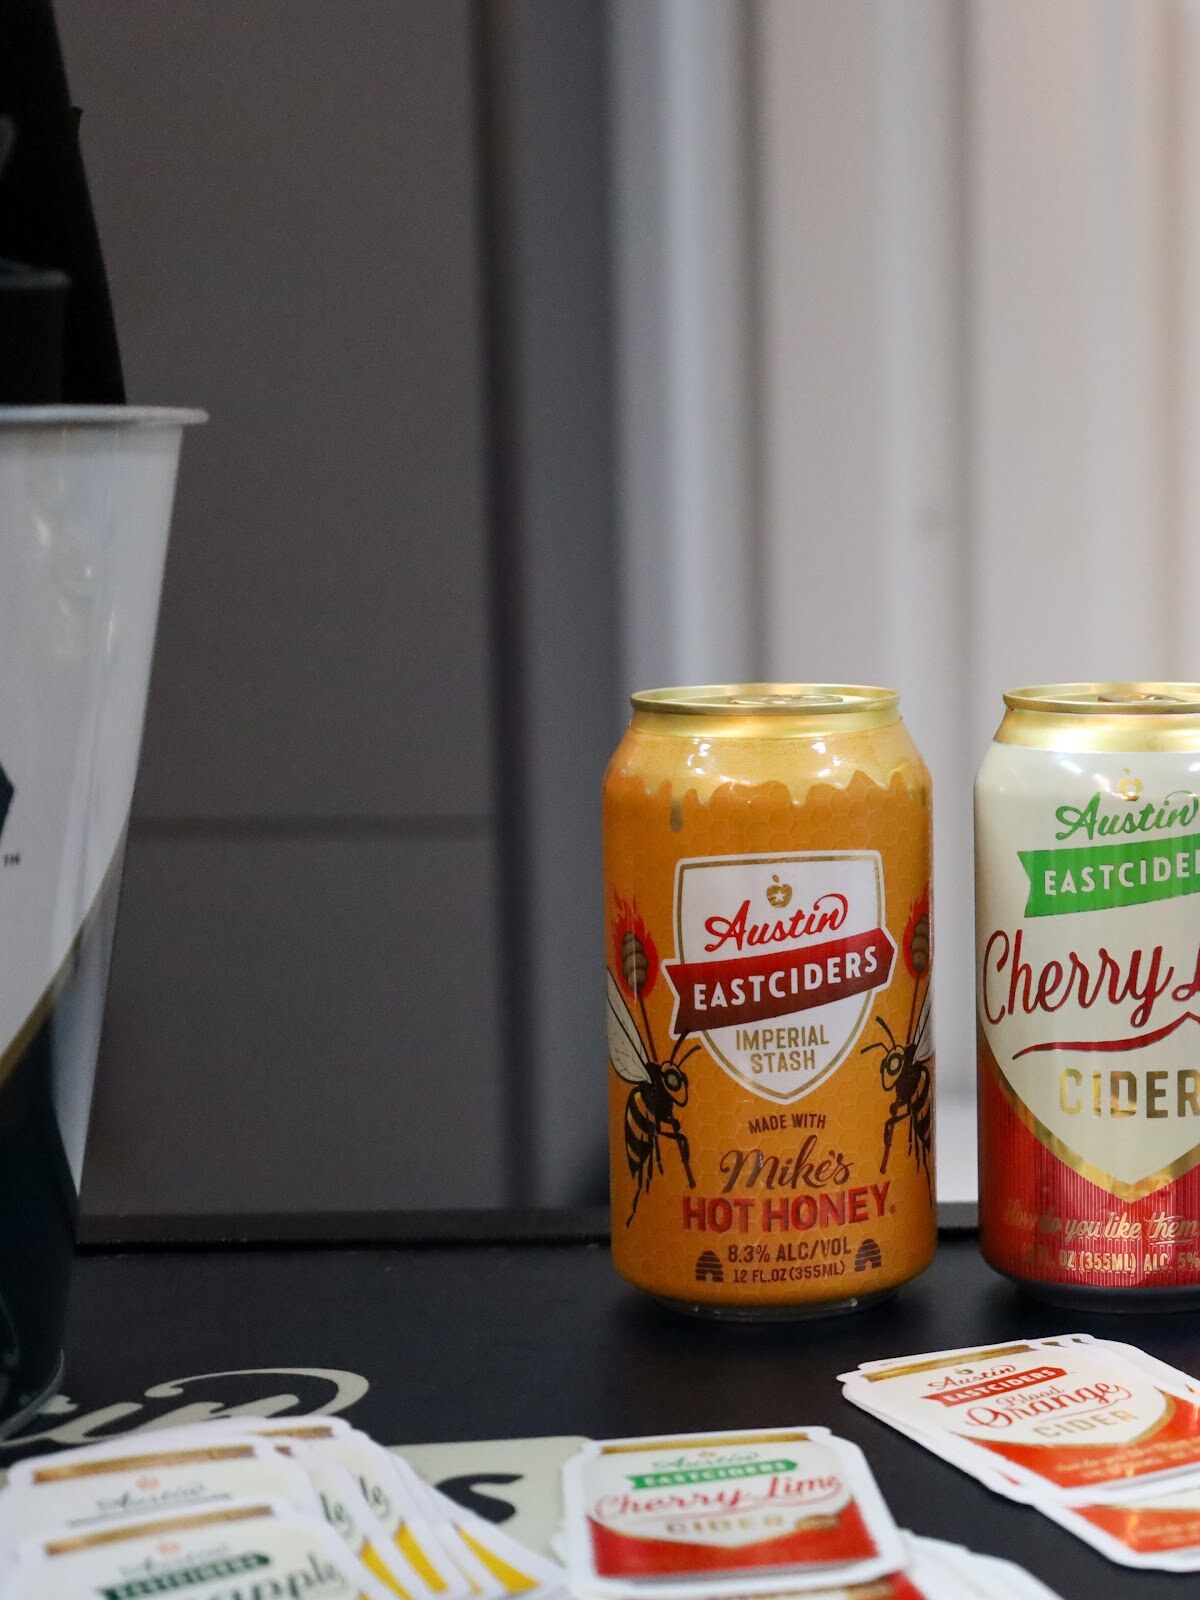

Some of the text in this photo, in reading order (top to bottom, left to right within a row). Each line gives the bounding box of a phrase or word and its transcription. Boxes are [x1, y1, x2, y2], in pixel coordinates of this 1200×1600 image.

[1055, 790, 1200, 841] Austin
[704, 893, 849, 952] Austin
[693, 945, 878, 1011] EASTCIDERS
[983, 929, 1175, 1028] Cherry
[735, 1024, 829, 1051] IMPERIAL
[750, 1048, 816, 1075] STASH
[749, 1113, 826, 1134] MADE WITH
[719, 1134, 854, 1193] Mike's
[682, 1181, 892, 1233] HOT HONEY
[1064, 1219, 1103, 1243] you
[1103, 1211, 1143, 1240] like
[728, 1236, 852, 1264] 8.3% ALC/VOL
[1059, 1249, 1077, 1270] OZ
[1079, 1249, 1138, 1275] (355ML)
[734, 1269, 748, 1284] 12
[927, 1364, 1017, 1391] Austin
[942, 1368, 1057, 1401] EASTCIDERS
[964, 1382, 1133, 1429] Orange
[995, 1385, 1065, 1408] Blood
[1033, 1410, 1140, 1439] CIDER
